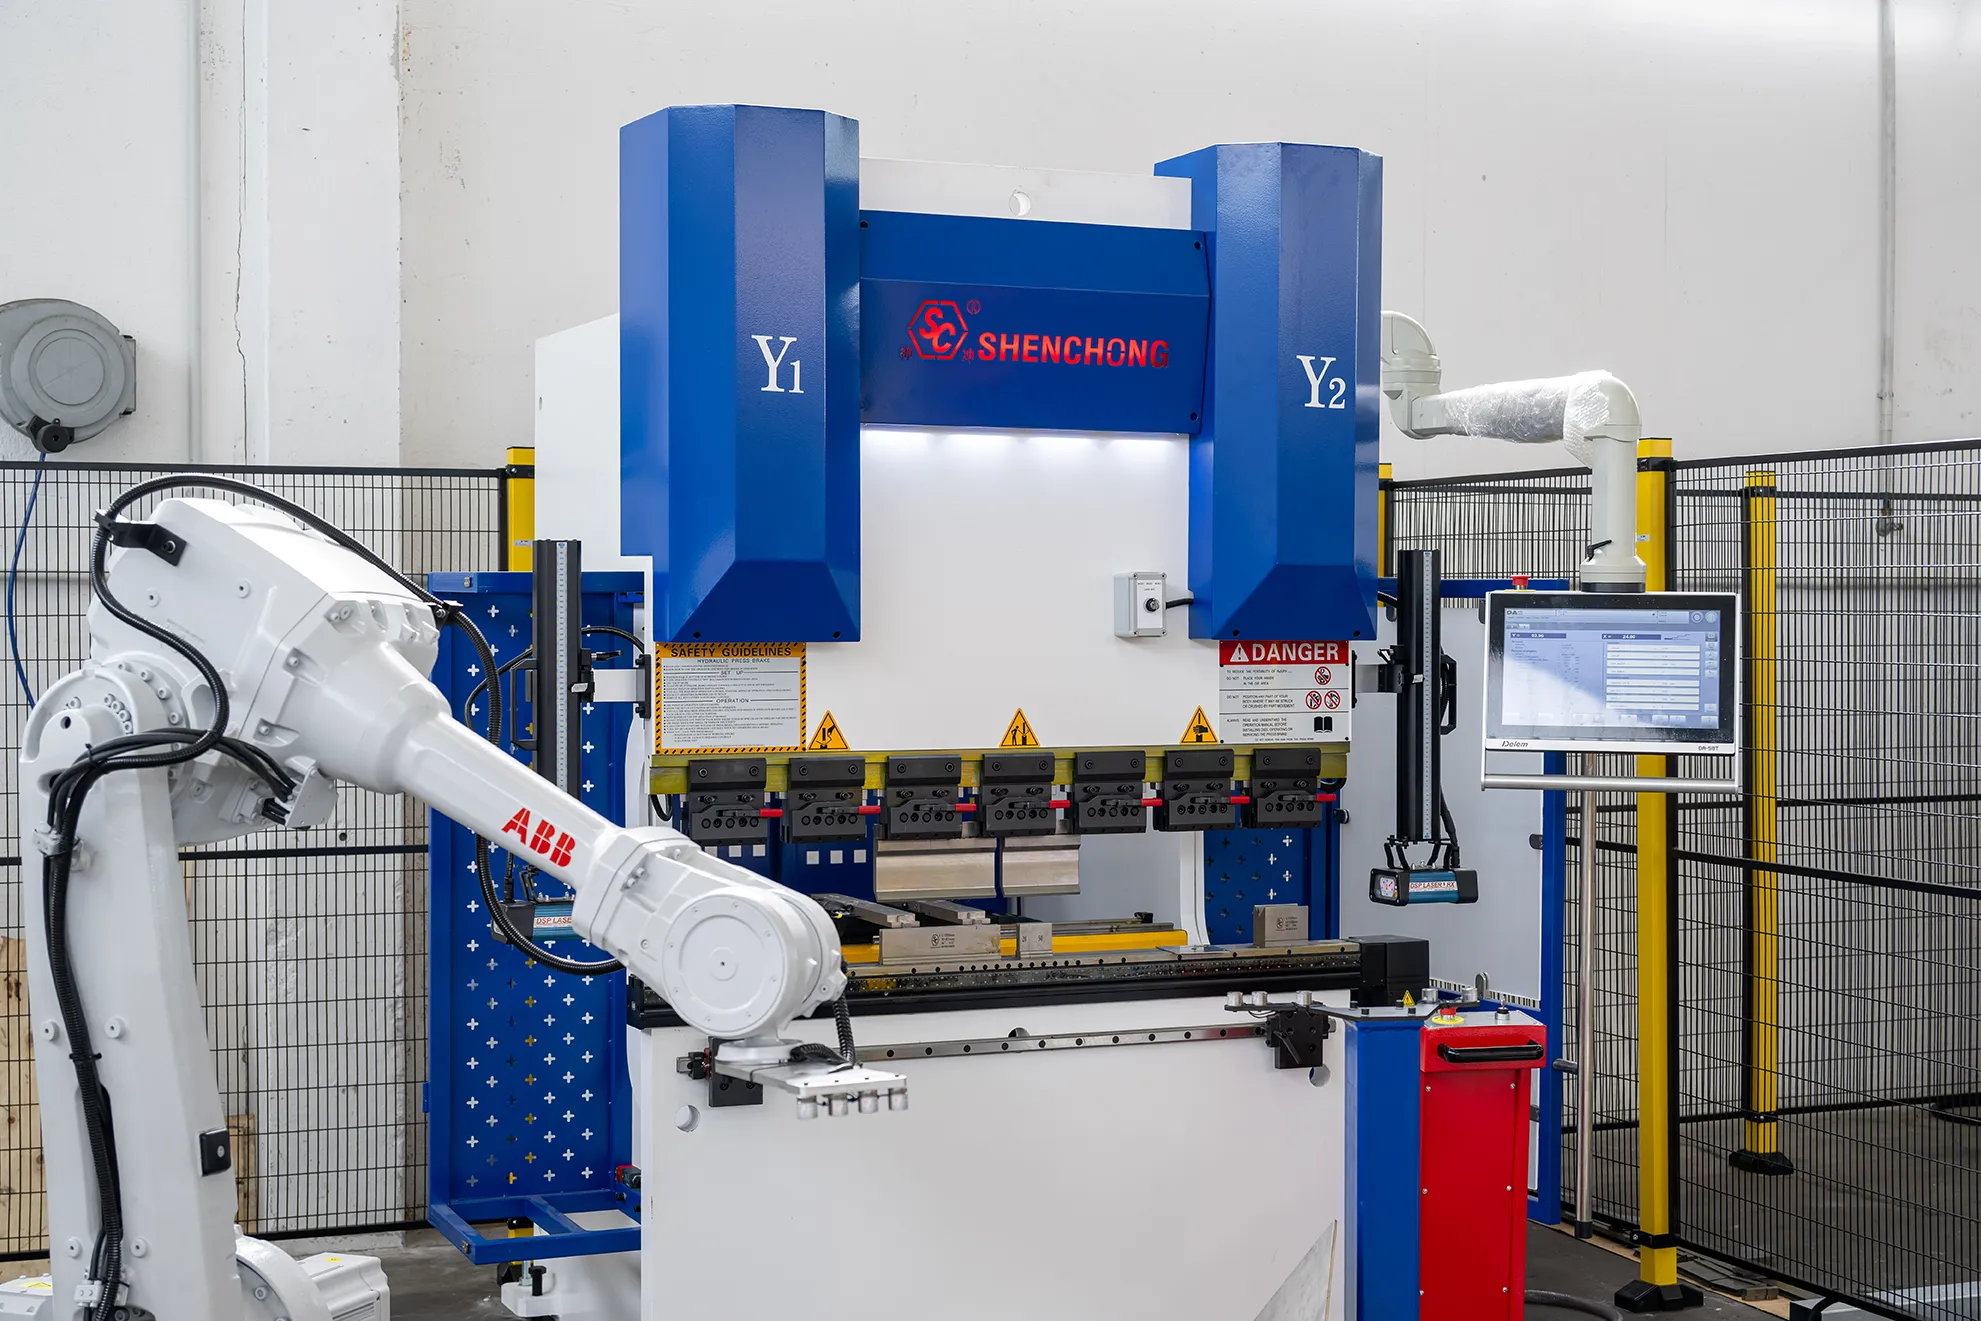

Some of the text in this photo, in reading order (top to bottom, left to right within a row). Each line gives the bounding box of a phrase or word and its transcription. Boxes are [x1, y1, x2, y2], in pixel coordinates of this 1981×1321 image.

[978, 331, 1170, 368] SHENCHONG
[751, 334, 805, 394] Y1
[1296, 354, 1346, 409] Y2
[671, 647, 792, 658] SAFETY GUIDELINES
[1252, 642, 1339, 662] DANGER
[1501, 740, 1529, 748] Delem
[501, 807, 576, 868] ABB
[1423, 881, 1442, 889] LASER
[536, 916, 572, 925] DSP LASE
